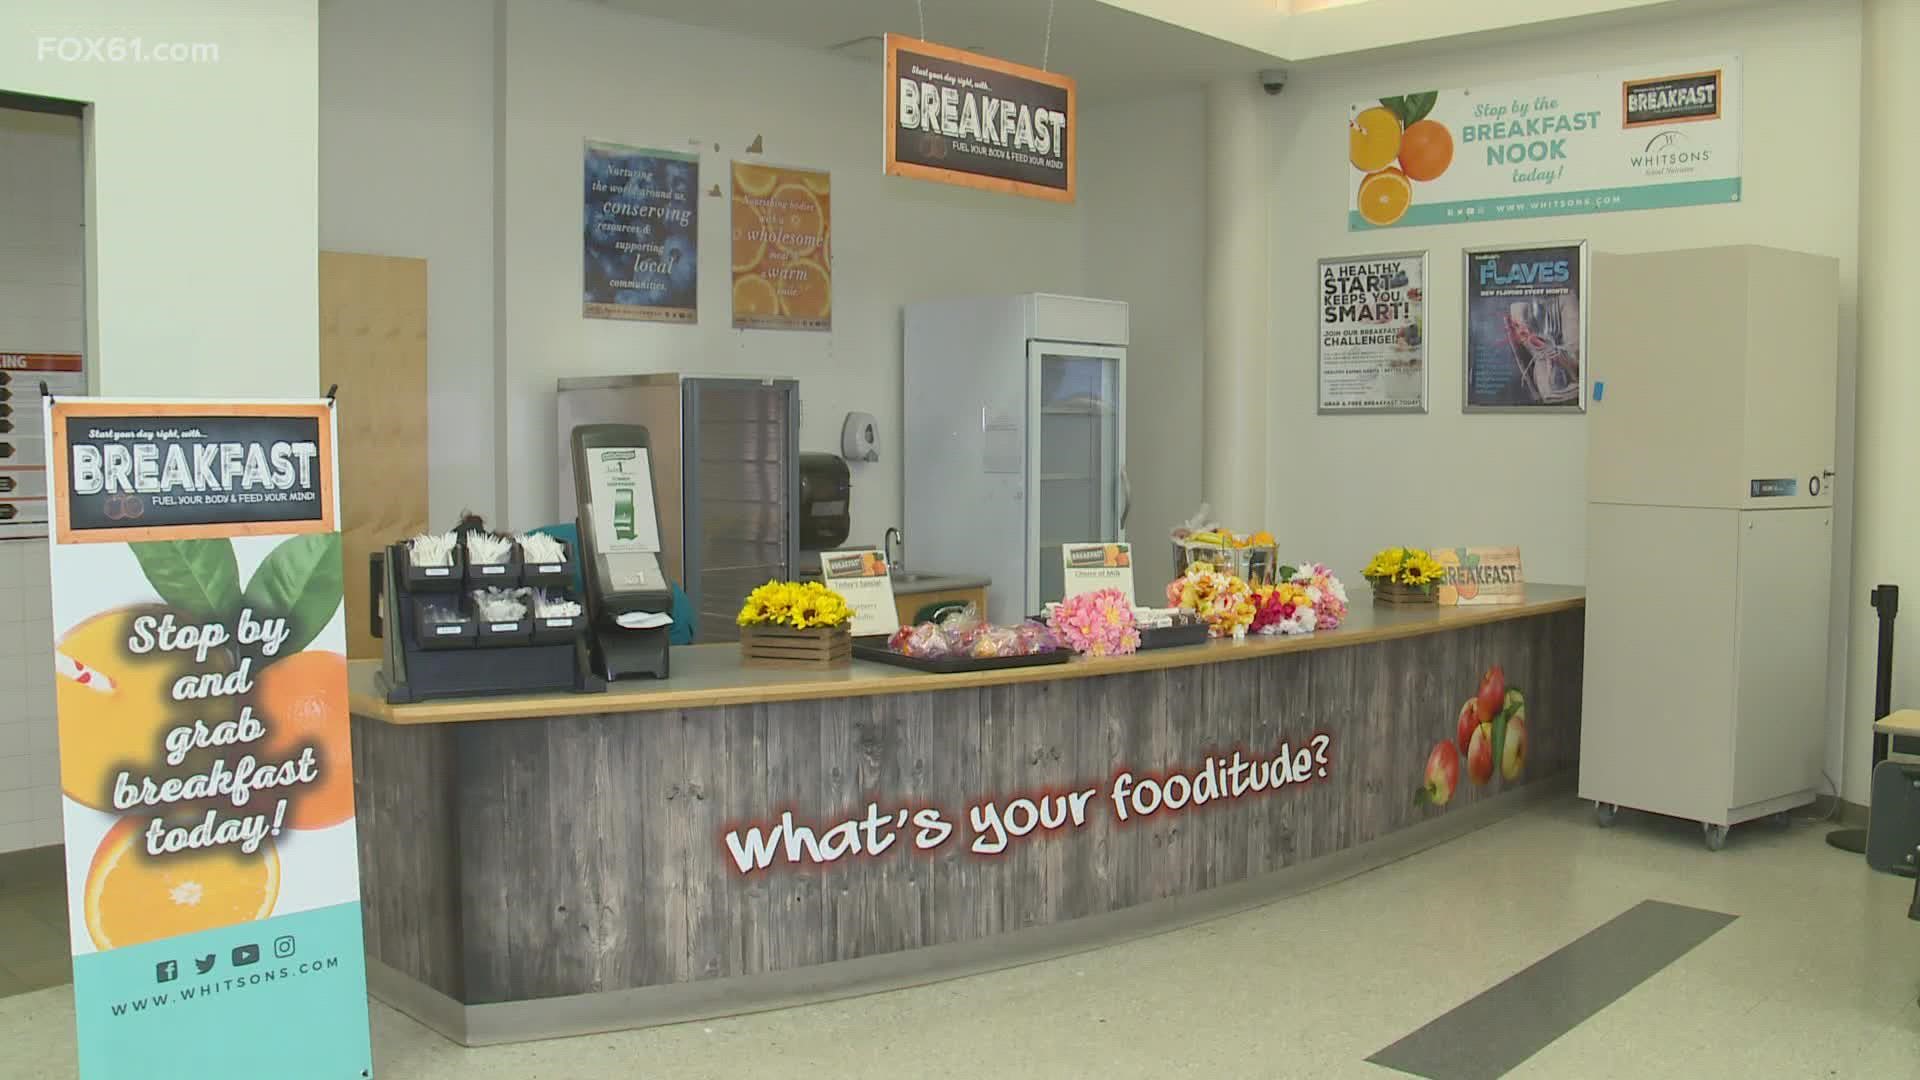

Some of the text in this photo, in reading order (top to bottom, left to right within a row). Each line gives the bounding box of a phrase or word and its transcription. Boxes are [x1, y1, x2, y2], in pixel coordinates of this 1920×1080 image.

[911, 64, 928, 77] Start
[928, 71, 943, 81] your
[943, 73, 956, 86] day
[1473, 97, 1558, 120] Stop by the
[1628, 84, 1714, 113] BREAKFAST
[900, 78, 1066, 158] BREAKFAST
[1462, 111, 1600, 143] BREAKFAST
[952, 140, 969, 152] FUEL
[970, 143, 988, 156] YOUR
[988, 147, 1005, 159] BODY
[1011, 151, 1028, 163] FEED
[1029, 155, 1045, 166] YOUR
[1486, 139, 1566, 166] NOOK
[1630, 151, 1709, 168] WHITSONS
[607, 164, 653, 181] Nurturing
[591, 180, 608, 191] the
[639, 188, 673, 200] around
[603, 201, 691, 227] conserving
[1496, 194, 1620, 213] WWW.WHITSONS.COM
[597, 223, 641, 234] resources
[747, 225, 824, 247] wholesome
[615, 241, 665, 256] supporting
[633, 254, 674, 274] local
[768, 267, 808, 281] warm
[1324, 262, 1400, 278] A HEALTHY
[1324, 274, 1393, 295] START
[1324, 291, 1400, 306] KEEPS YOU
[1324, 302, 1409, 323] SMART!
[88, 429, 113, 439] Start
[114, 431, 135, 441] your
[136, 429, 154, 441] day
[72, 441, 317, 495] BREAKFAST
[152, 491, 316, 506] FUEL YOUR BODY & FEED YOUR MIND!
[1440, 564, 1516, 584] BREAKFAST
[129, 608, 290, 662] Stop by
[172, 657, 253, 701] and
[165, 707, 265, 766] grab
[113, 748, 318, 809] breakfast
[970, 786, 1097, 855] your
[1112, 733, 1330, 821] fooditude?
[145, 799, 288, 855] today!
[111, 957, 339, 1016] WWW.WHITSONS.COM
